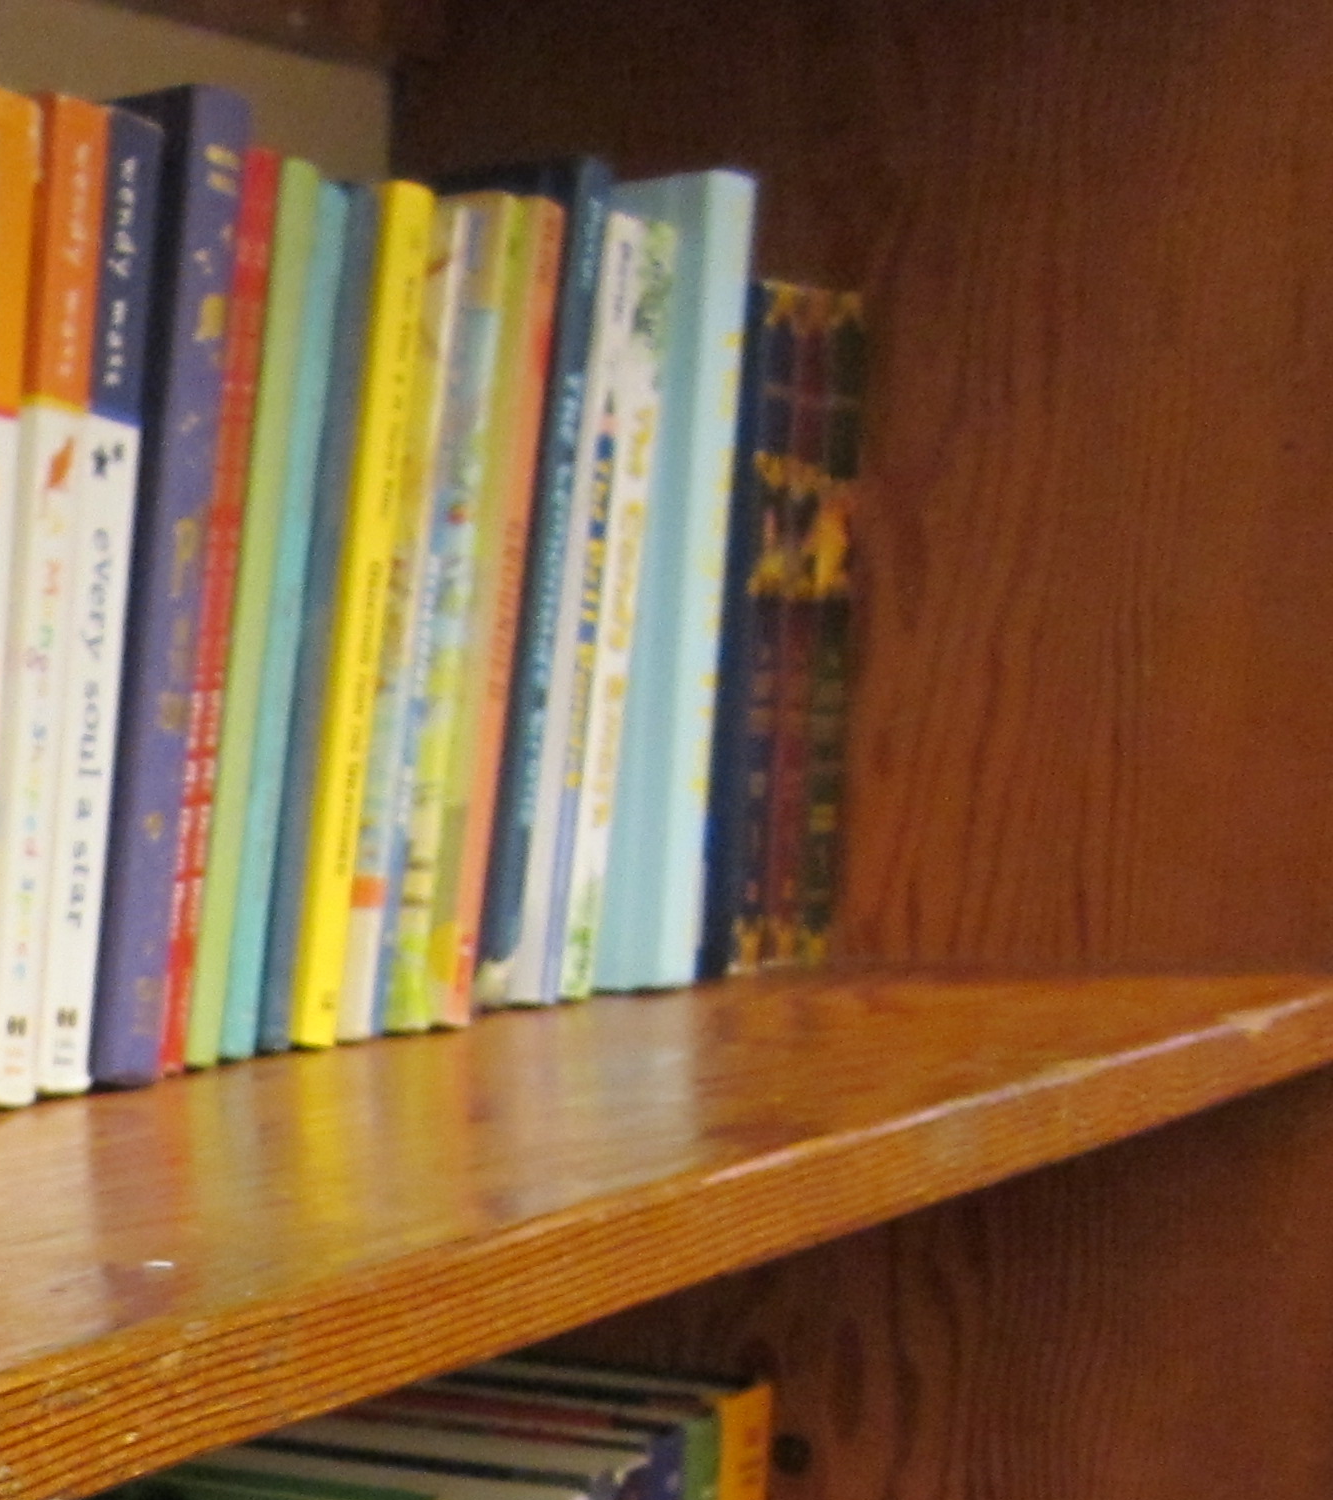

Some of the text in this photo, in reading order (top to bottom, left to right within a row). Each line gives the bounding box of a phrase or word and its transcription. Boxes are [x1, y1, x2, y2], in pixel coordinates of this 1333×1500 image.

[79, 528, 111, 663] every
[78, 678, 103, 780] soul
[66, 838, 91, 930] star
